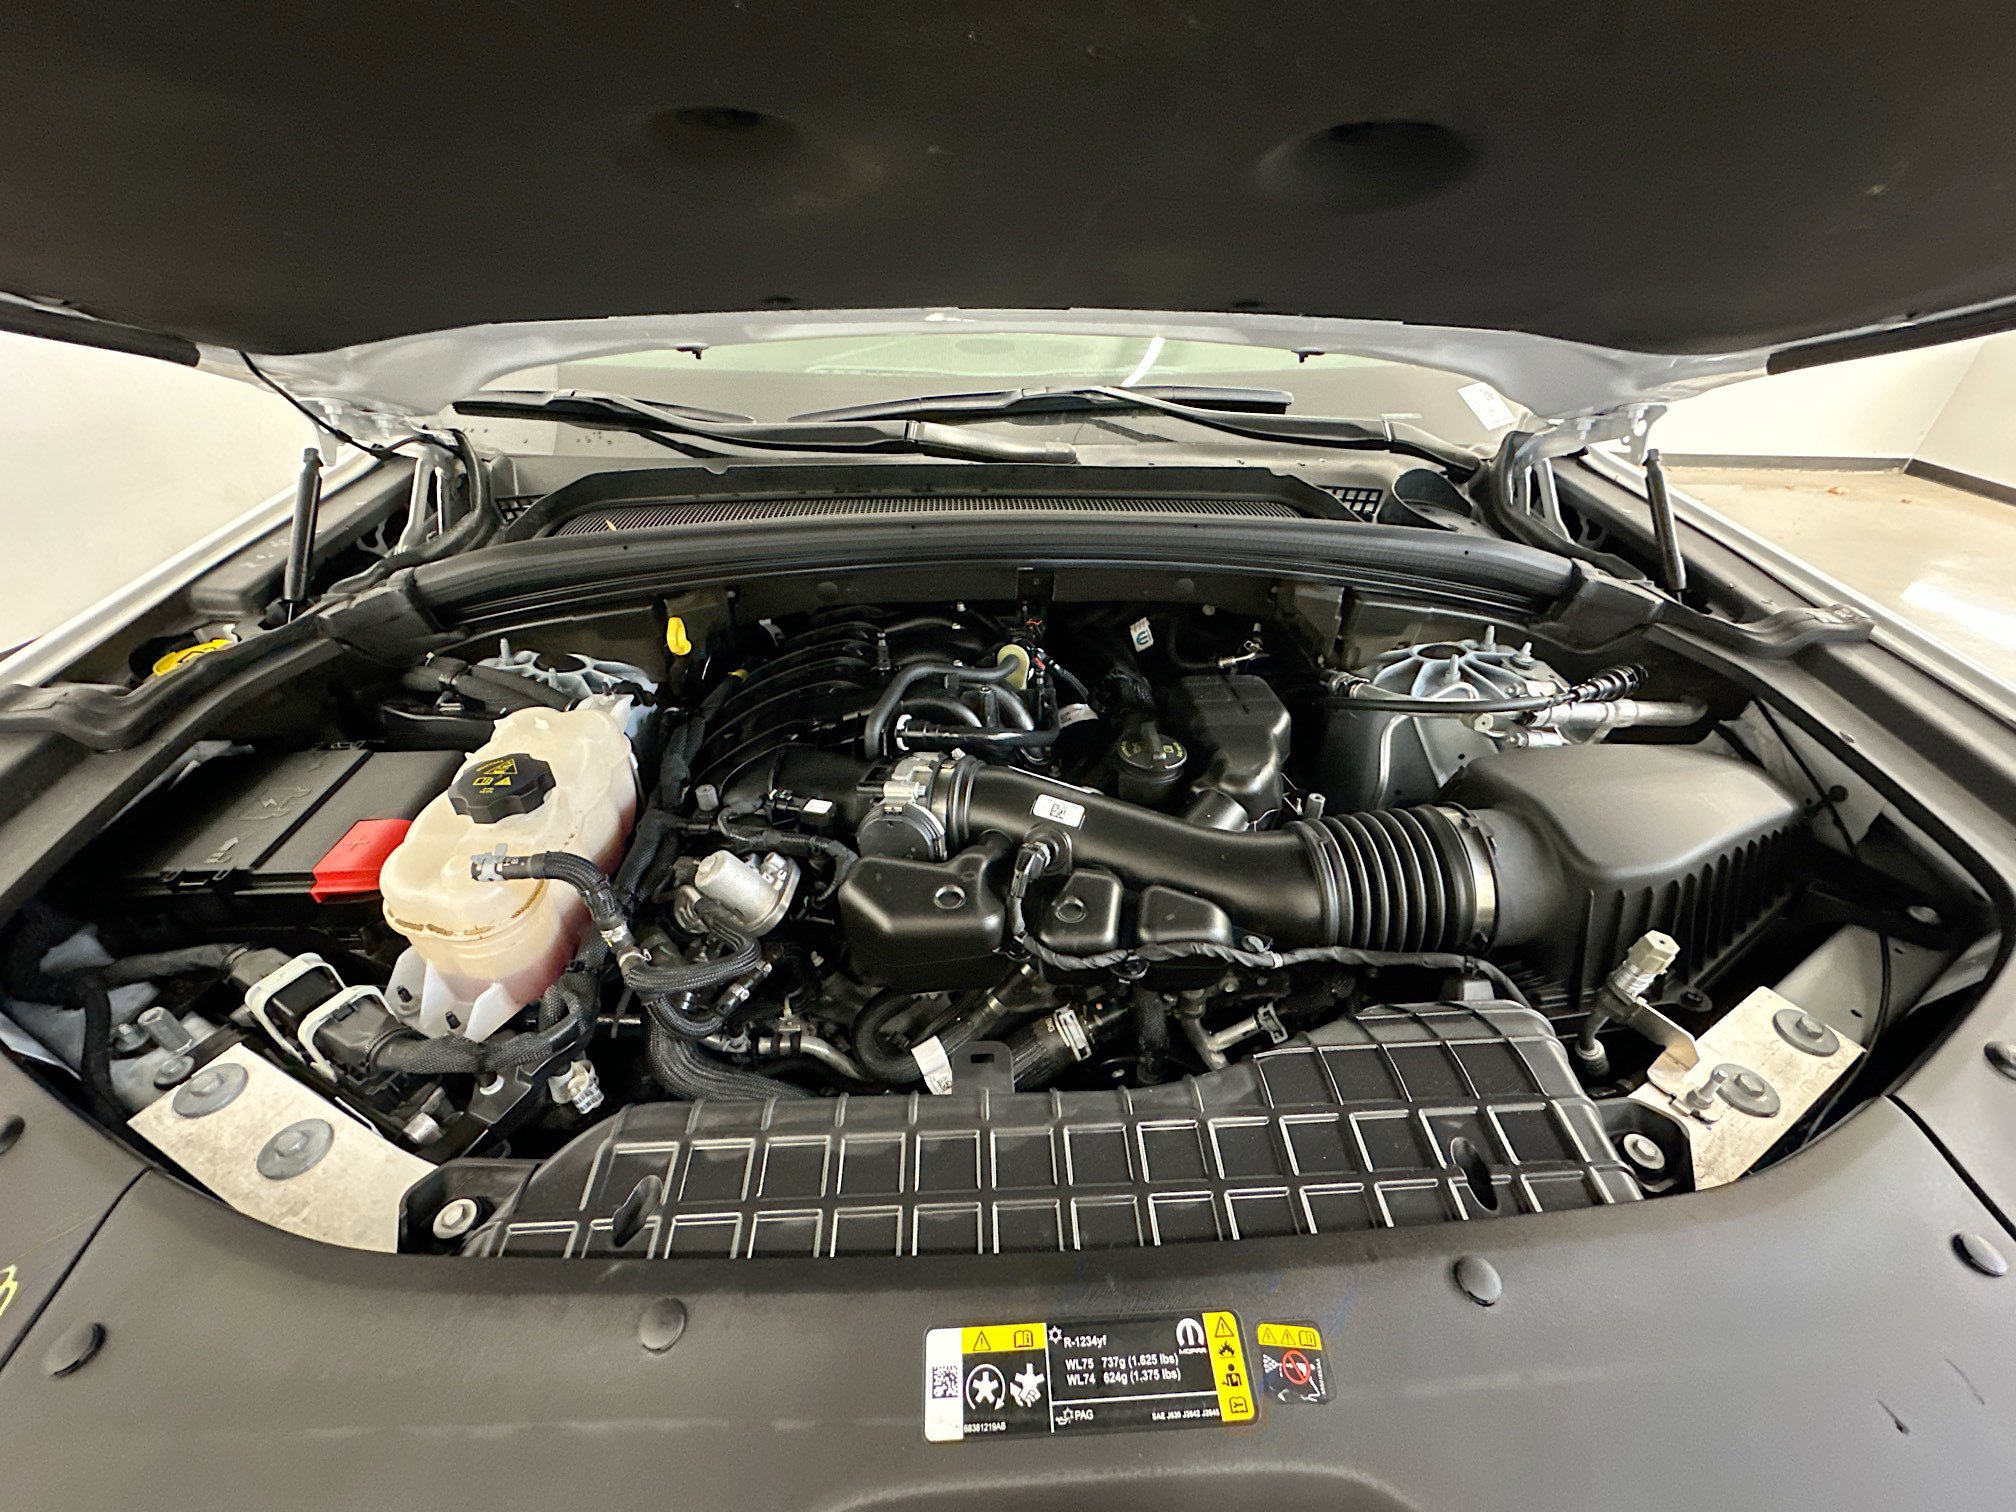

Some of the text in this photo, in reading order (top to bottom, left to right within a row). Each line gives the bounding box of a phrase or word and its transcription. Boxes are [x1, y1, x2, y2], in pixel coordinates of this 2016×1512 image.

[1063, 1334, 1107, 1349] R-1234yf
[1178, 1347, 1207, 1355] MOPAR
[1065, 1352, 1179, 1371] WL75 737g (1.625 lbs)
[1066, 1373, 1096, 1386] WL74
[1103, 1371, 1128, 1385] 624g
[1162, 1367, 1181, 1382] lbs)
[1074, 1408, 1094, 1421] PAG
[1151, 1411, 1166, 1421] SAE
